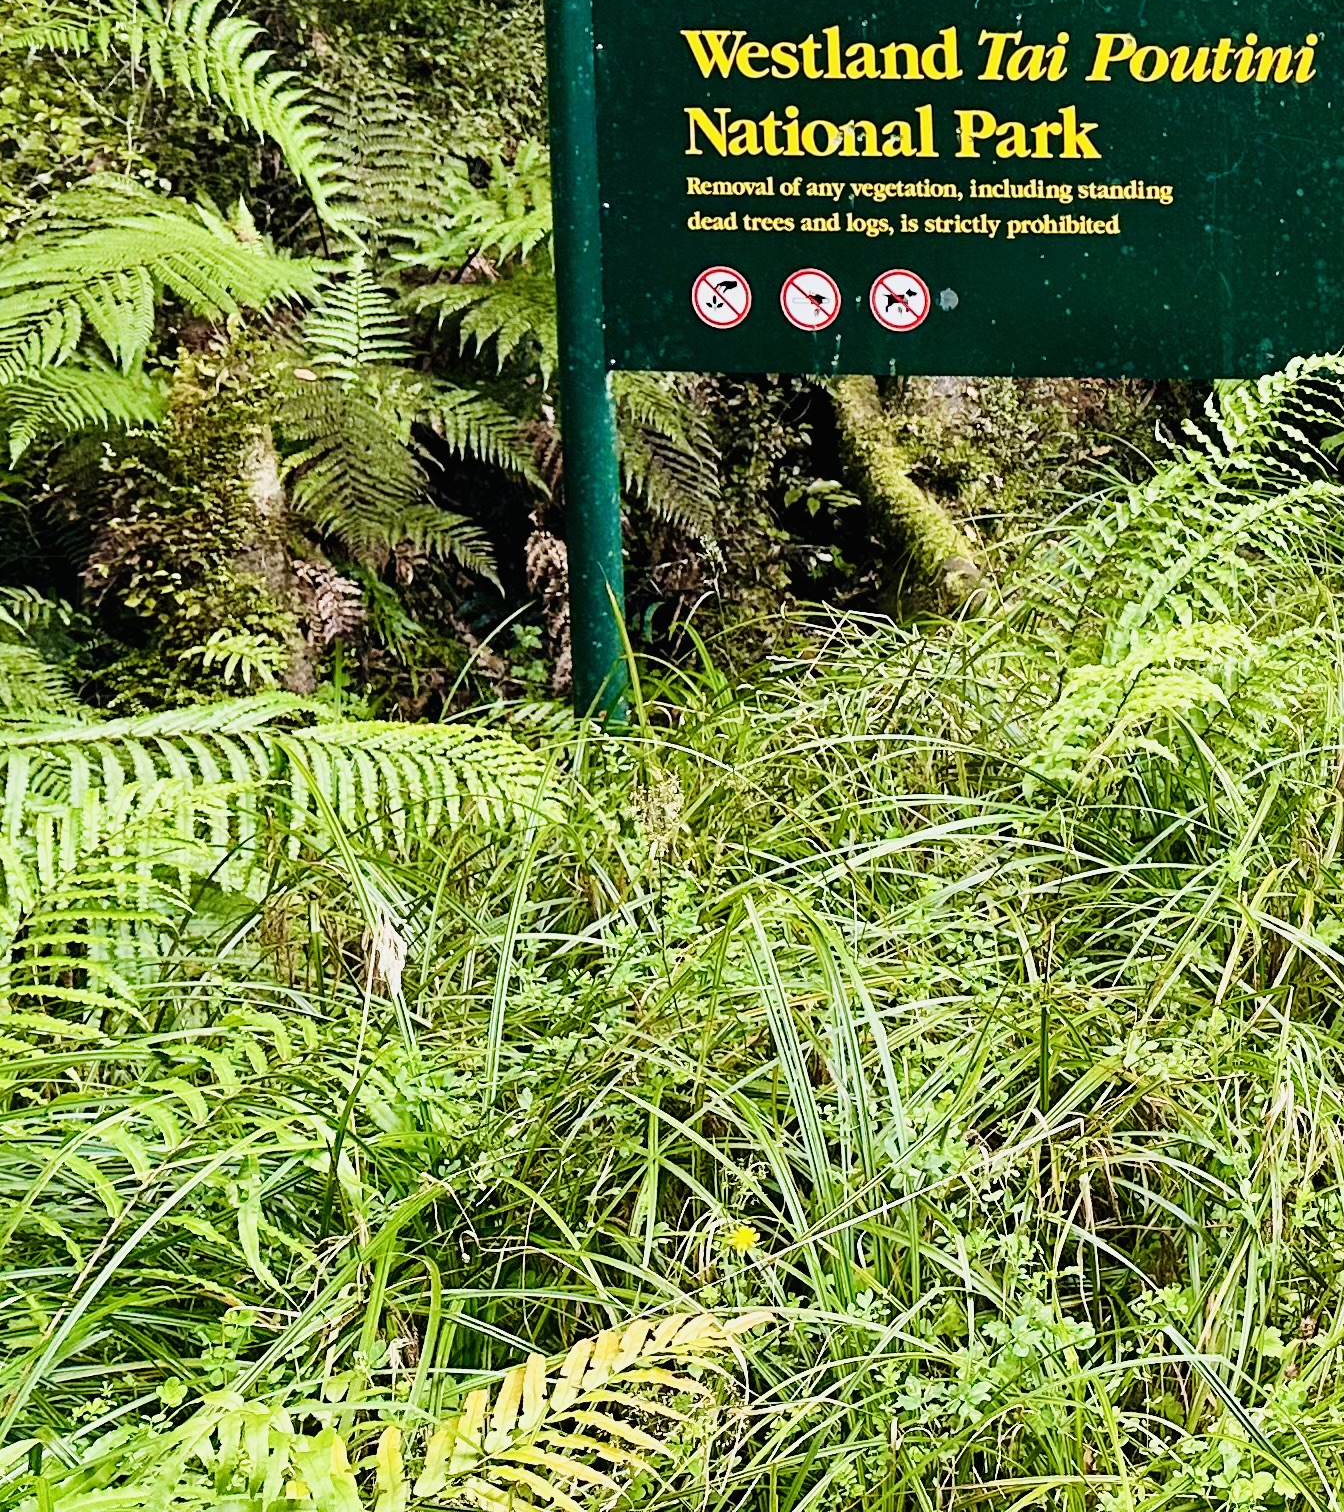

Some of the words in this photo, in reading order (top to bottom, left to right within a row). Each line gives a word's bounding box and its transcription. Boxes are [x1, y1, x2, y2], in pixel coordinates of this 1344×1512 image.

[680, 26, 963, 80] Westland
[977, 30, 1069, 82] Tai
[1084, 32, 1318, 84] Poutini
[684, 104, 939, 158] National
[954, 105, 1102, 159] Park
[686, 176, 775, 196] Removal
[779, 176, 804, 196] of
[806, 182, 845, 201] any
[850, 178, 963, 202] vegetation,
[969, 178, 1073, 204] including
[1077, 180, 1174, 204] standing
[687, 211, 738, 231] dead
[743, 213, 795, 231] trees
[800, 212, 841, 232] and
[845, 212, 894, 238] logs,
[900, 213, 919, 232] is
[924, 213, 1002, 238] strictly
[1006, 213, 1121, 239] prohibited
